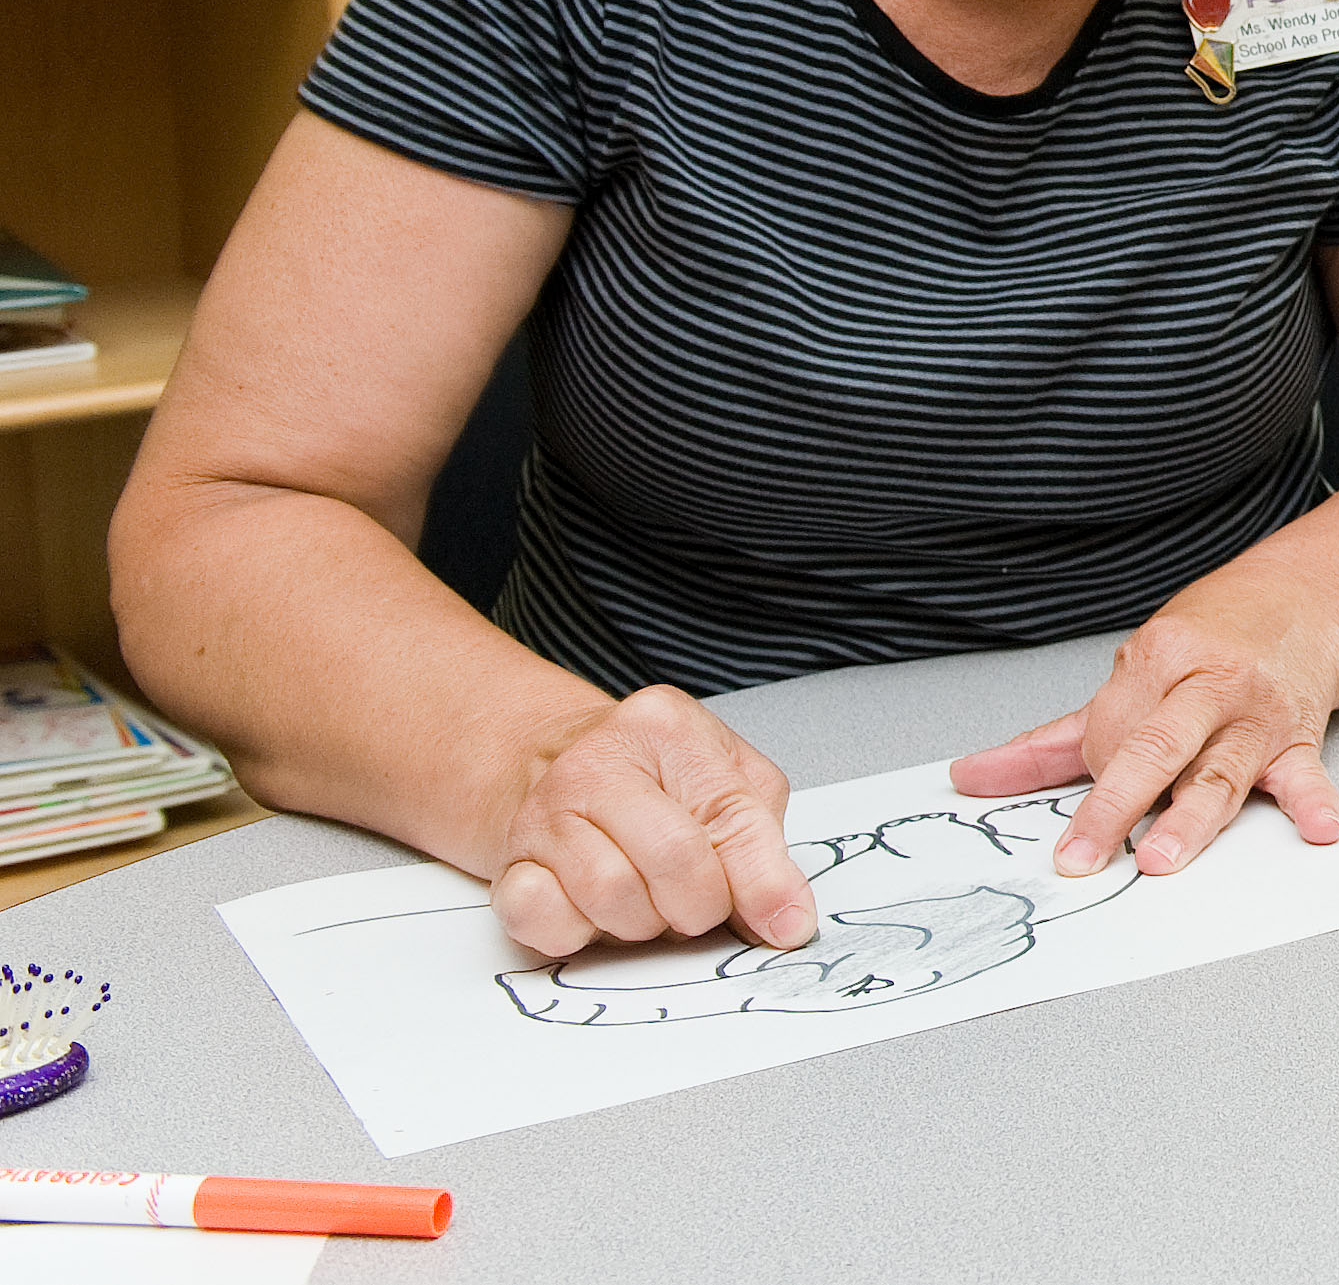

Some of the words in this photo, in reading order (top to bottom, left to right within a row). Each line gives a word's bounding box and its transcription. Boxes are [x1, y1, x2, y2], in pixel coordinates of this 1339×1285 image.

[1239, 22, 1266, 37] Ms.
[1267, 12, 1316, 32] Wendy
[1239, 37, 1287, 57] School
[1290, 34, 1318, 49] Age
